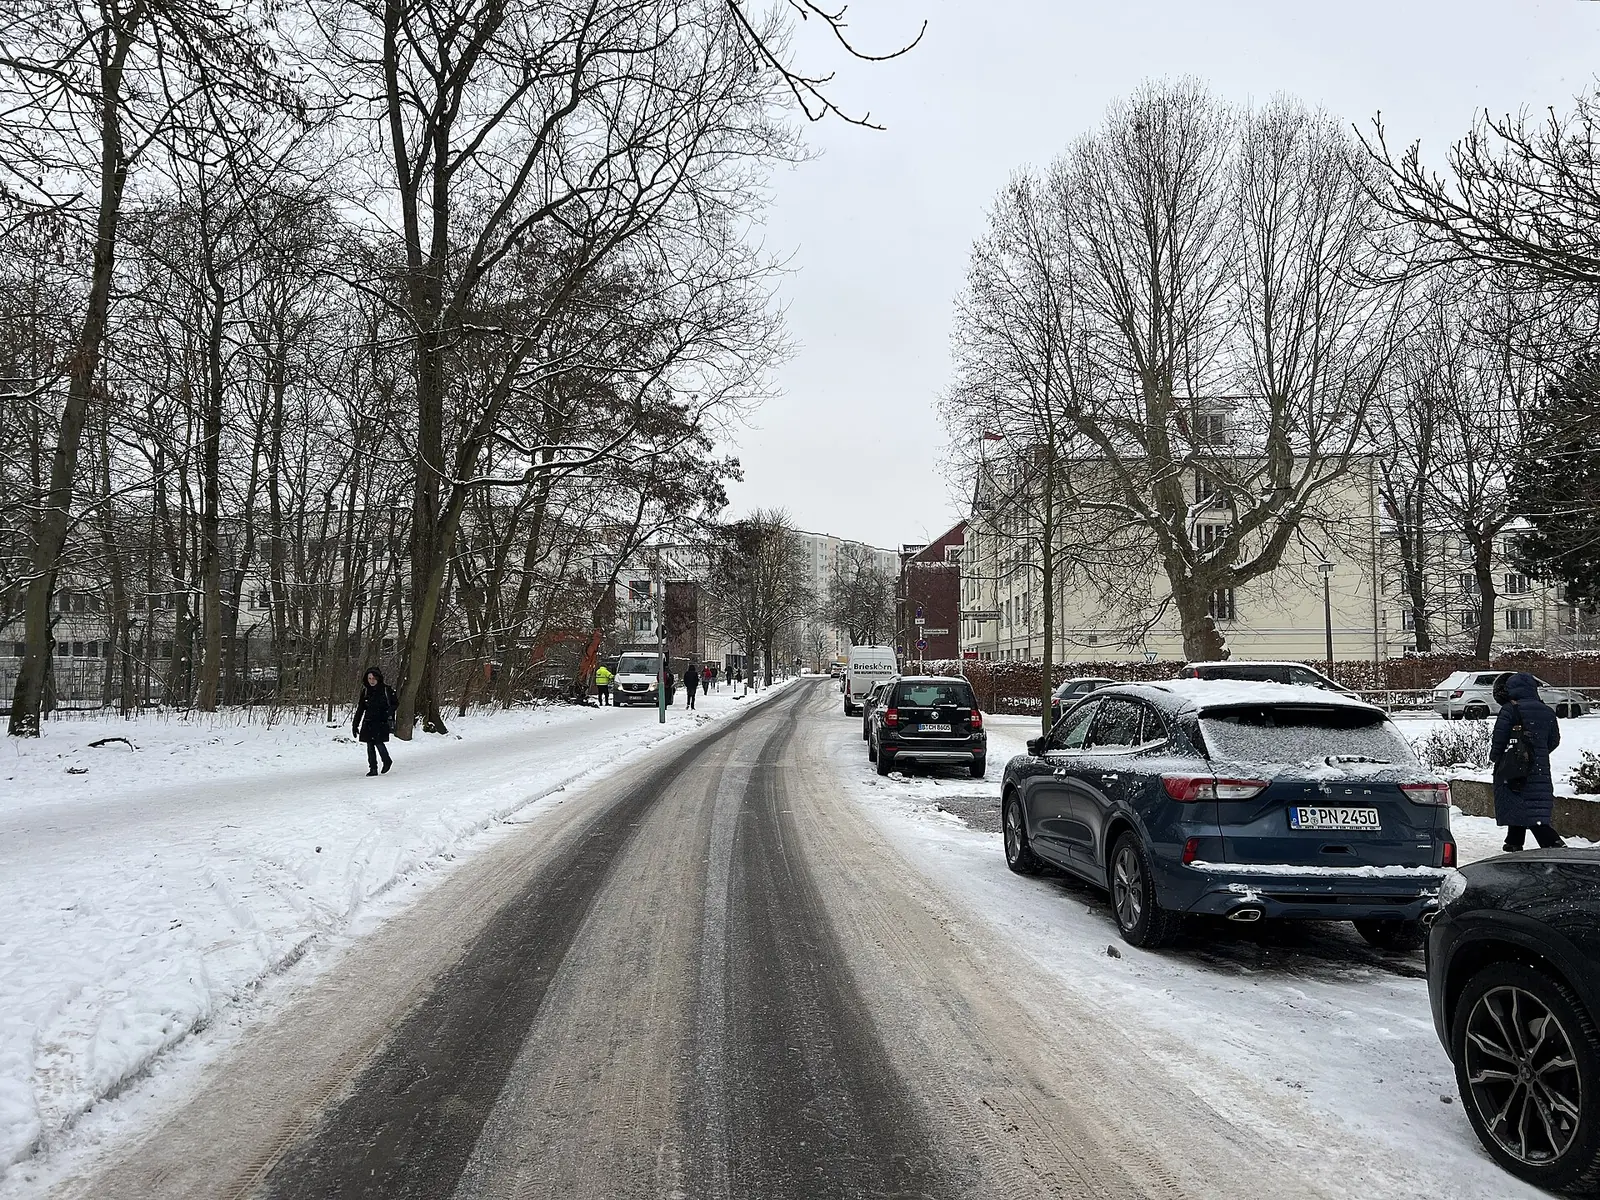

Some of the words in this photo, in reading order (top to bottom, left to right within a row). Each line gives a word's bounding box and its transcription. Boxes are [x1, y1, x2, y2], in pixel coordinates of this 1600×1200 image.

[1299, 808, 1310, 824] B
[1320, 808, 1339, 824] PN
[1341, 810, 1377, 825] 2450
